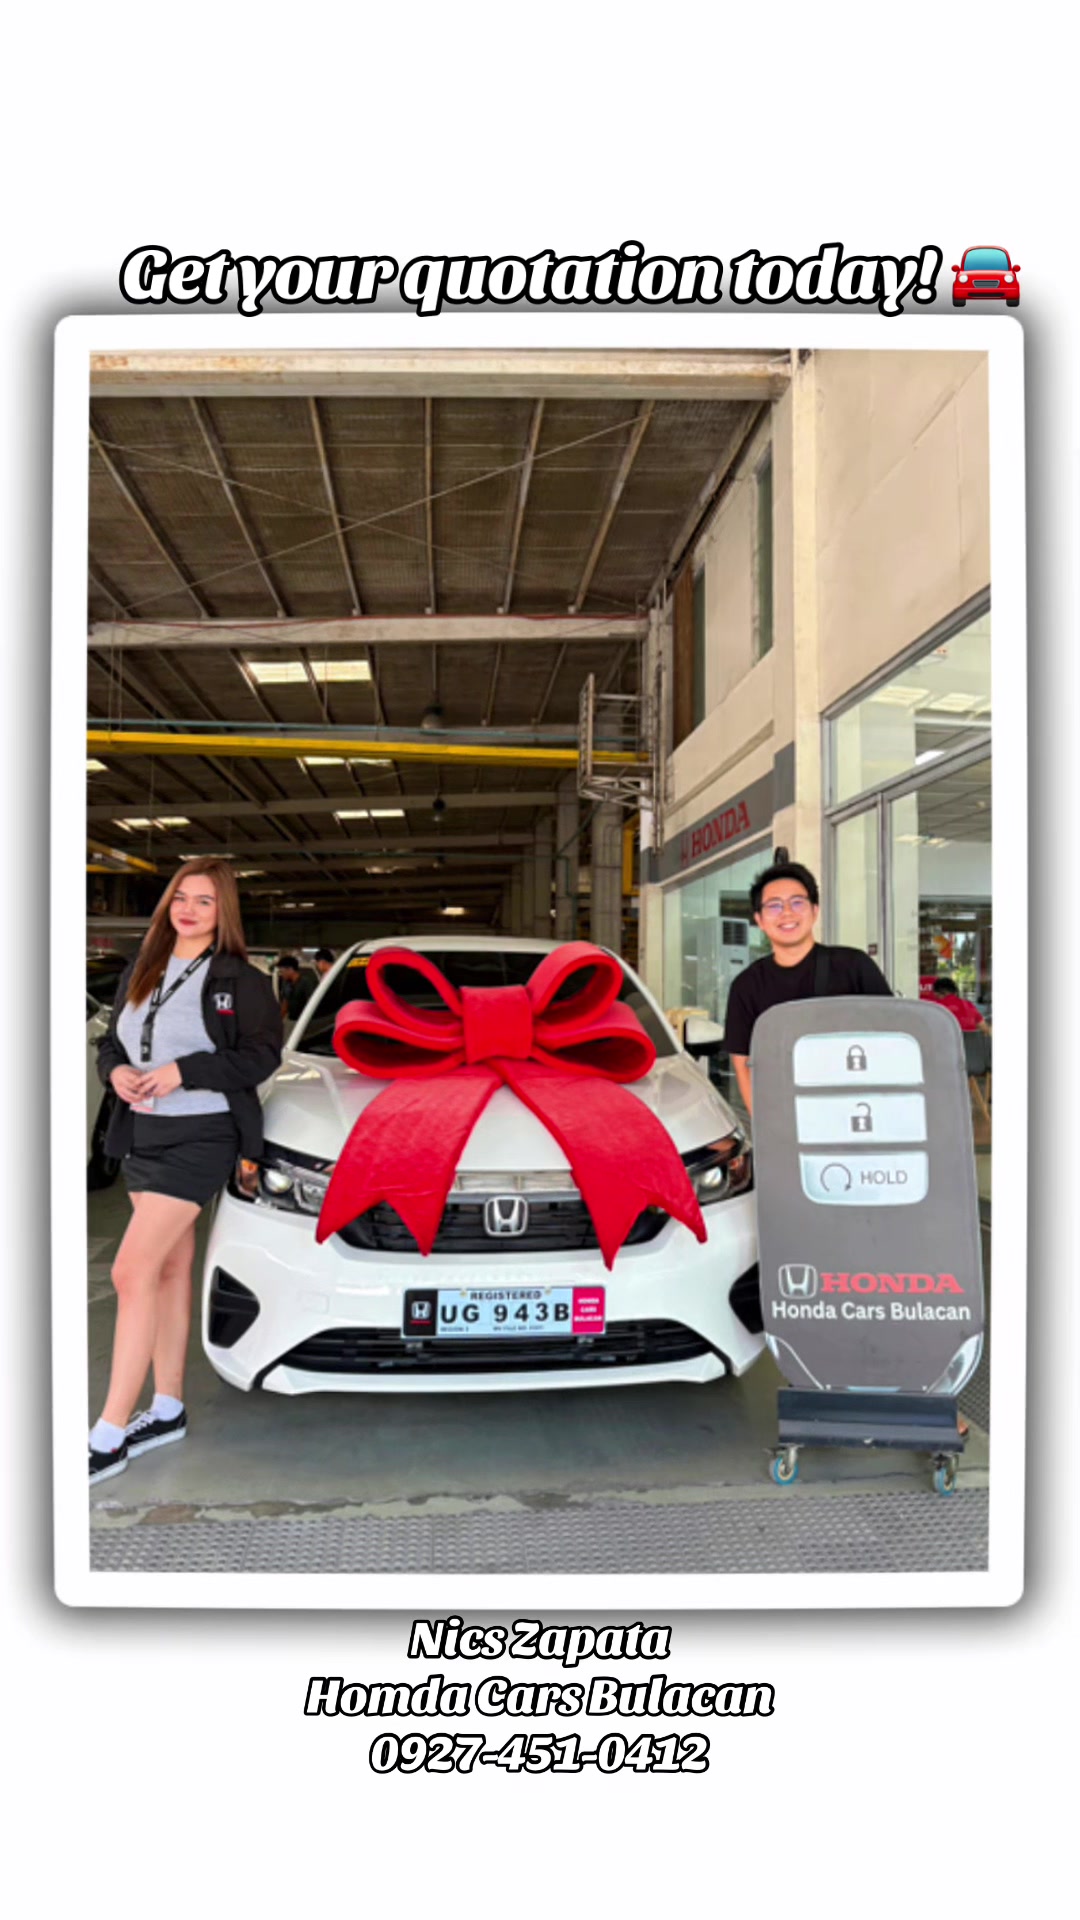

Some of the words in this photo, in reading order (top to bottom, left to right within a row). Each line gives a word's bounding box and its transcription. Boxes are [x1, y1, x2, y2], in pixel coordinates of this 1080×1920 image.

[691, 800, 751, 858] HONDA
[860, 1169, 909, 1185] HOLD
[819, 1272, 965, 1294] HONDA
[470, 1290, 543, 1300] REGISTERED
[440, 1304, 480, 1323] UG
[771, 1300, 838, 1320] Honda
[841, 1301, 886, 1321] Cars
[890, 1301, 971, 1321] Bulacan
